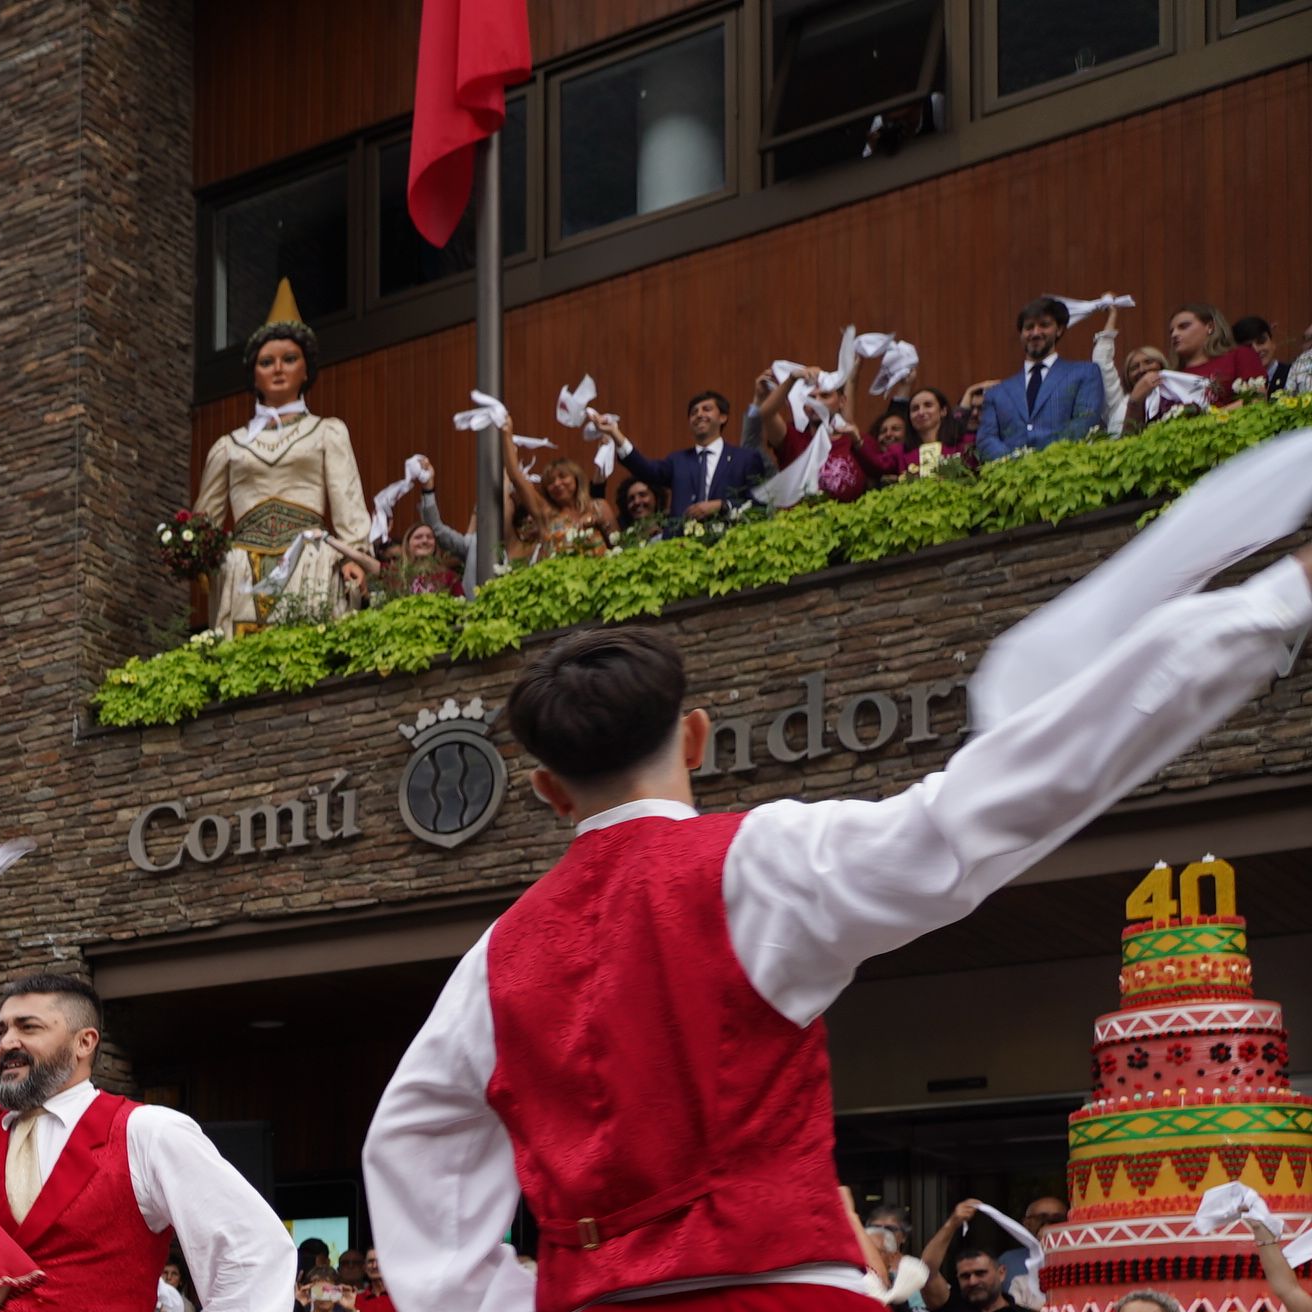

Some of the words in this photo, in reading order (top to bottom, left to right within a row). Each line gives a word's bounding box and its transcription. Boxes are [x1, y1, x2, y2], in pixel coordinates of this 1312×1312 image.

[128, 766, 361, 872] Comú
[692, 671, 978, 778] ndor
[1125, 857, 1236, 930] 40
